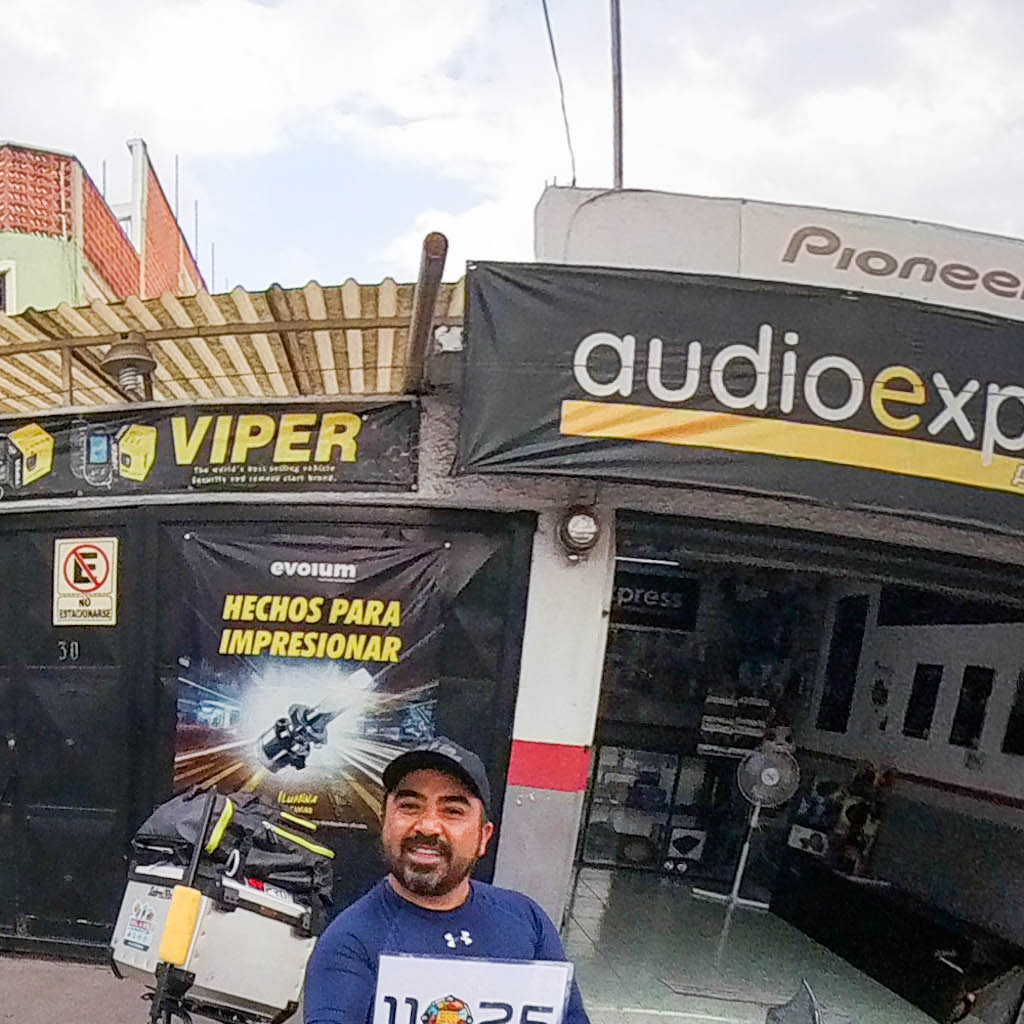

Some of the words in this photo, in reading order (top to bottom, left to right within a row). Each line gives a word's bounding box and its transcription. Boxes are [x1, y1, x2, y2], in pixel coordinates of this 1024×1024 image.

[780, 226, 1024, 300] Pionee
[171, 412, 363, 465] VIPER
[59, 609, 112, 619] ESTACIONARSE
[78, 599, 92, 608] NO
[222, 594, 325, 624] HECHOS
[329, 598, 401, 627] PARA
[57, 640, 80, 660] 30
[218, 629, 403, 663] IMPRESIONAR
